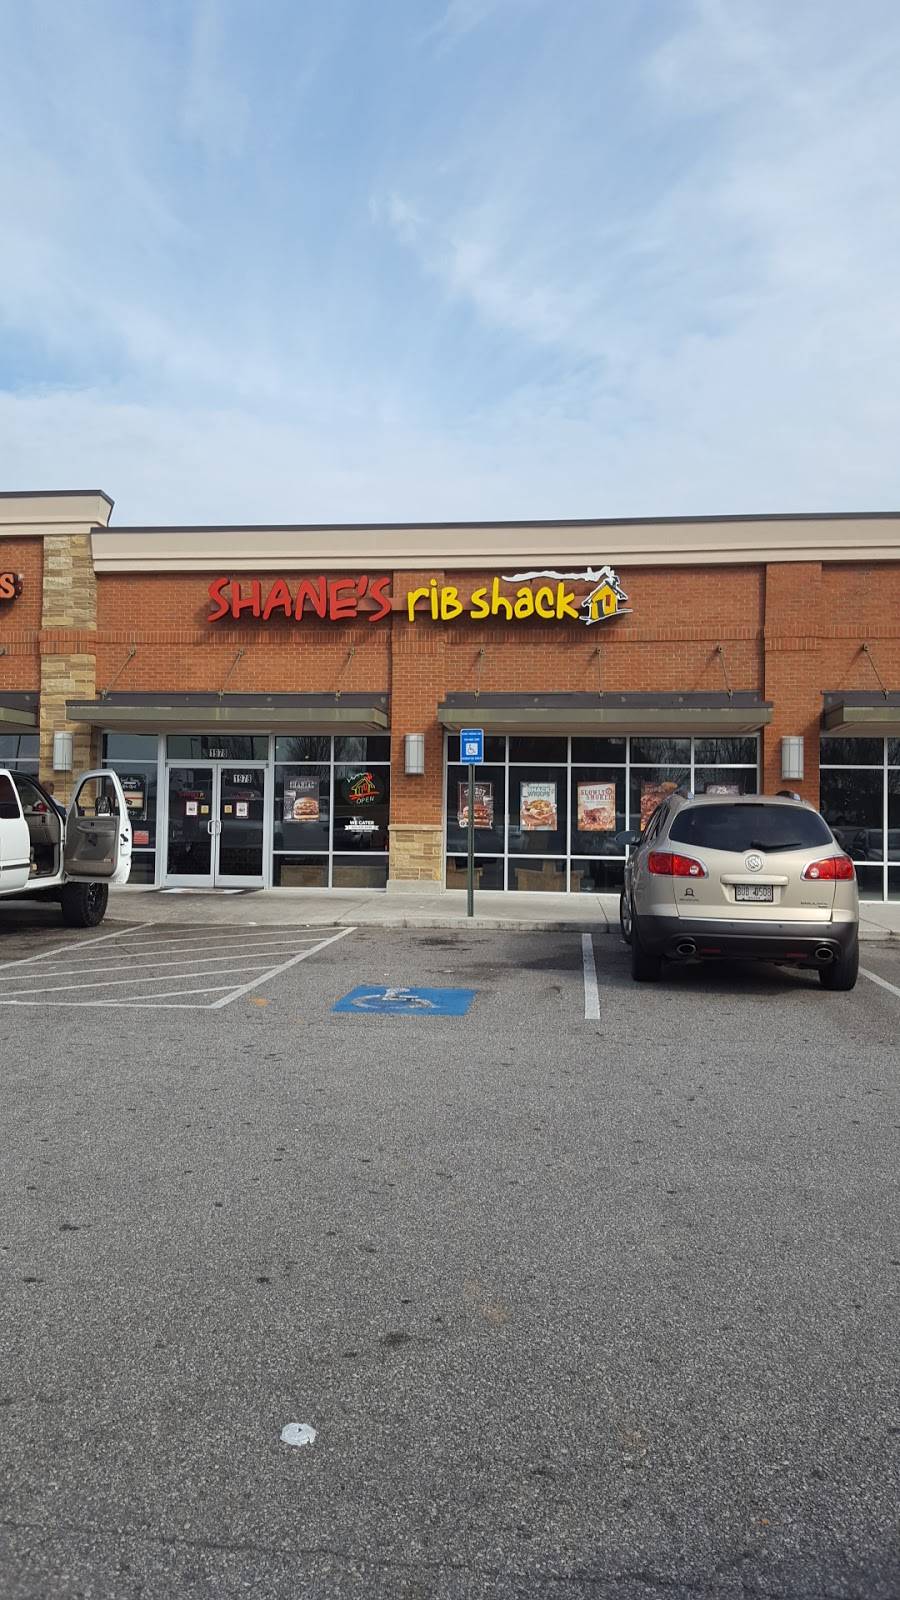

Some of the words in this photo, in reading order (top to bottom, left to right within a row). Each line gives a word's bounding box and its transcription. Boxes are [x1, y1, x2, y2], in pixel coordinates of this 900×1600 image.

[208, 575, 392, 622] SHANE'S
[470, 576, 579, 620] shack
[356, 796, 375, 805] OPEN
